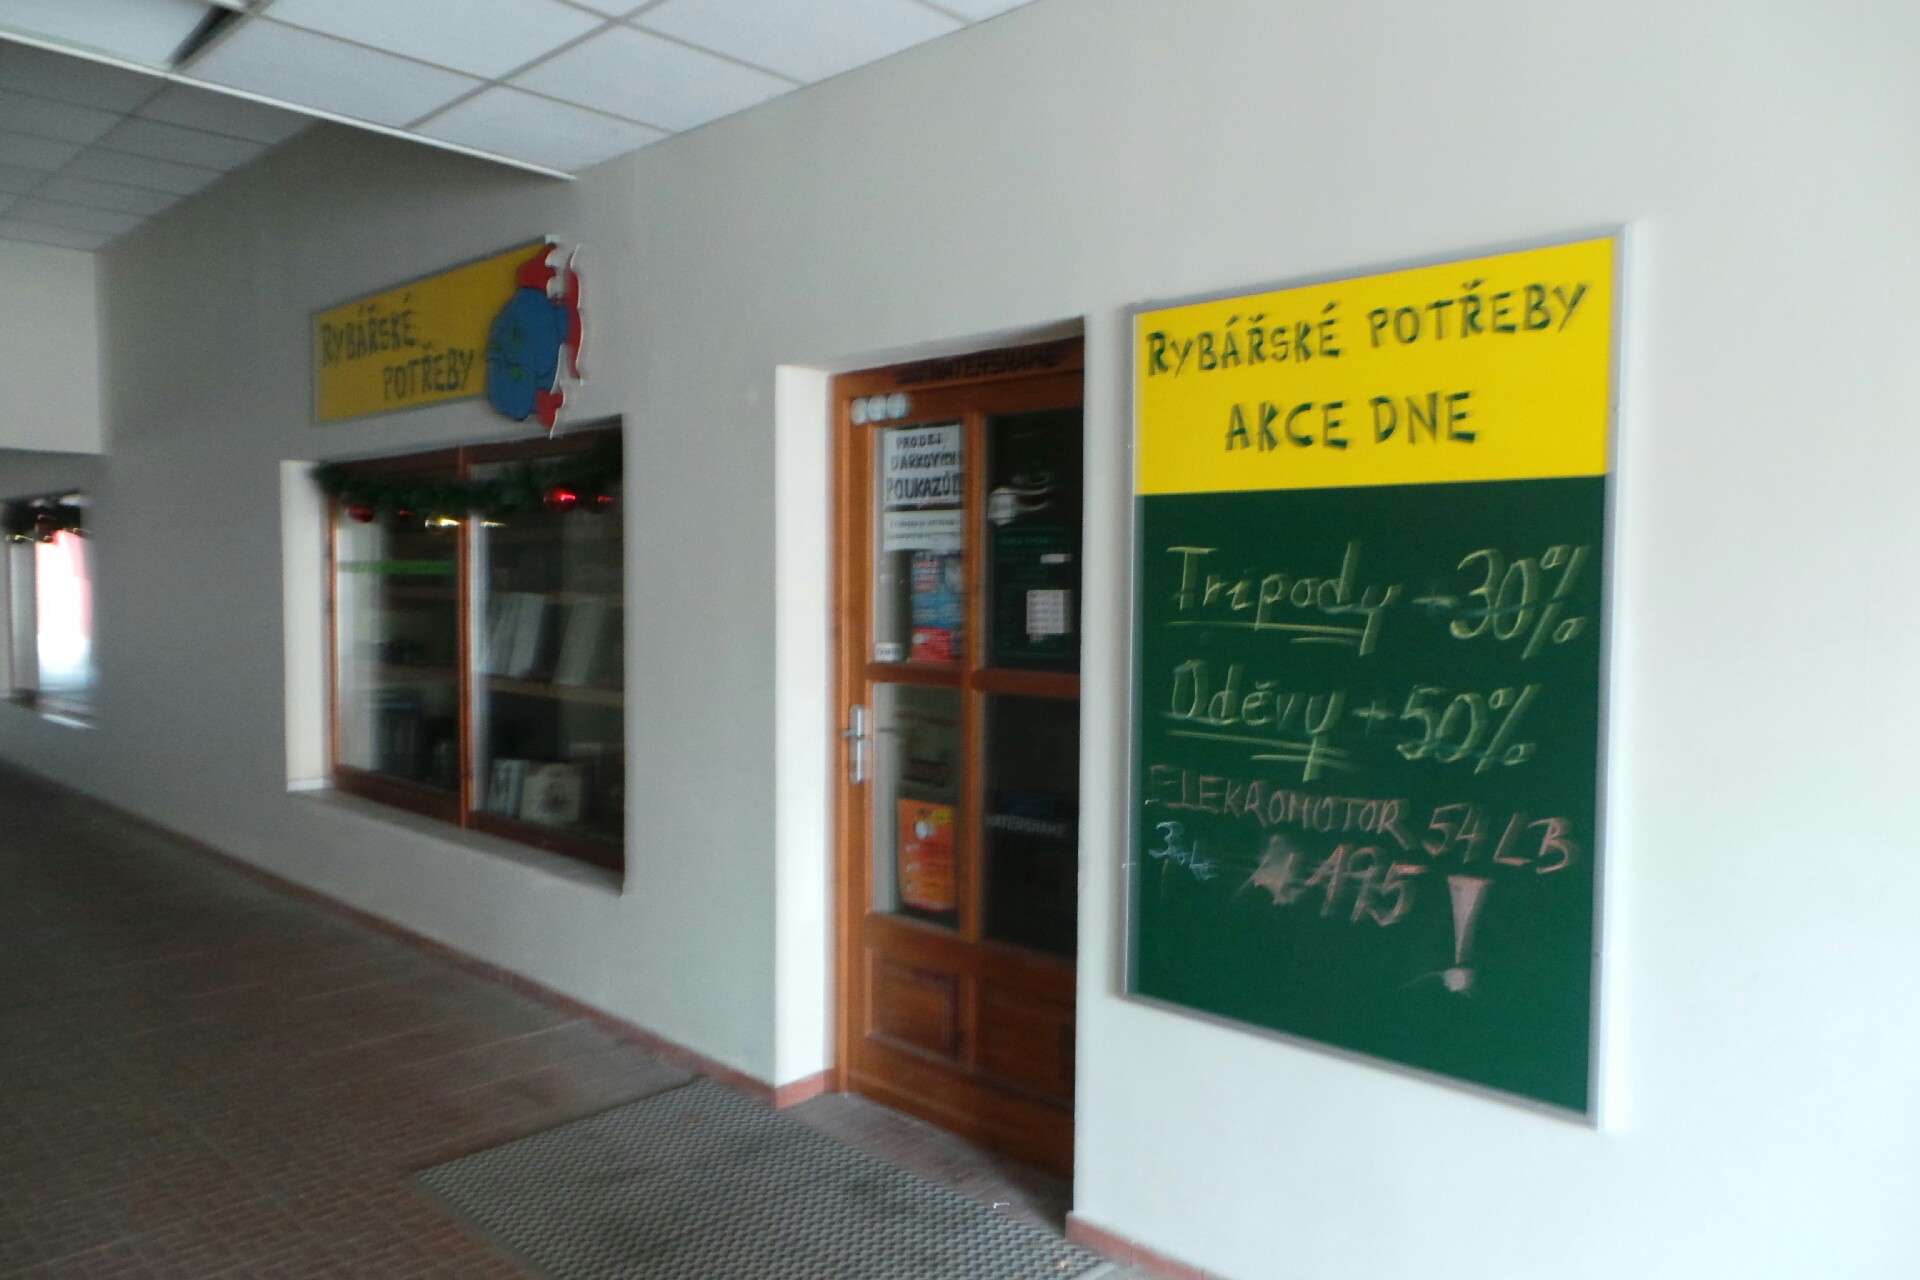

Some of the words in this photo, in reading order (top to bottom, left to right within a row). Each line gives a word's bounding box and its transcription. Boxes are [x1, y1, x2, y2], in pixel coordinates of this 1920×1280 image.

[322, 293, 416, 367] RYBÁŘSKÉ
[1146, 303, 1342, 378] RYBÁŘSKÉ
[1367, 280, 1588, 348] POTŘEBY
[382, 342, 475, 400] POTŘEBY
[896, 433, 941, 450] PRODEJ
[1225, 401, 1350, 452] AKCE
[1369, 392, 1478, 445] DNE
[1166, 541, 1403, 657] Tripody
[1423, 803, 1486, 865] 54
[1493, 812, 1578, 874] LB
